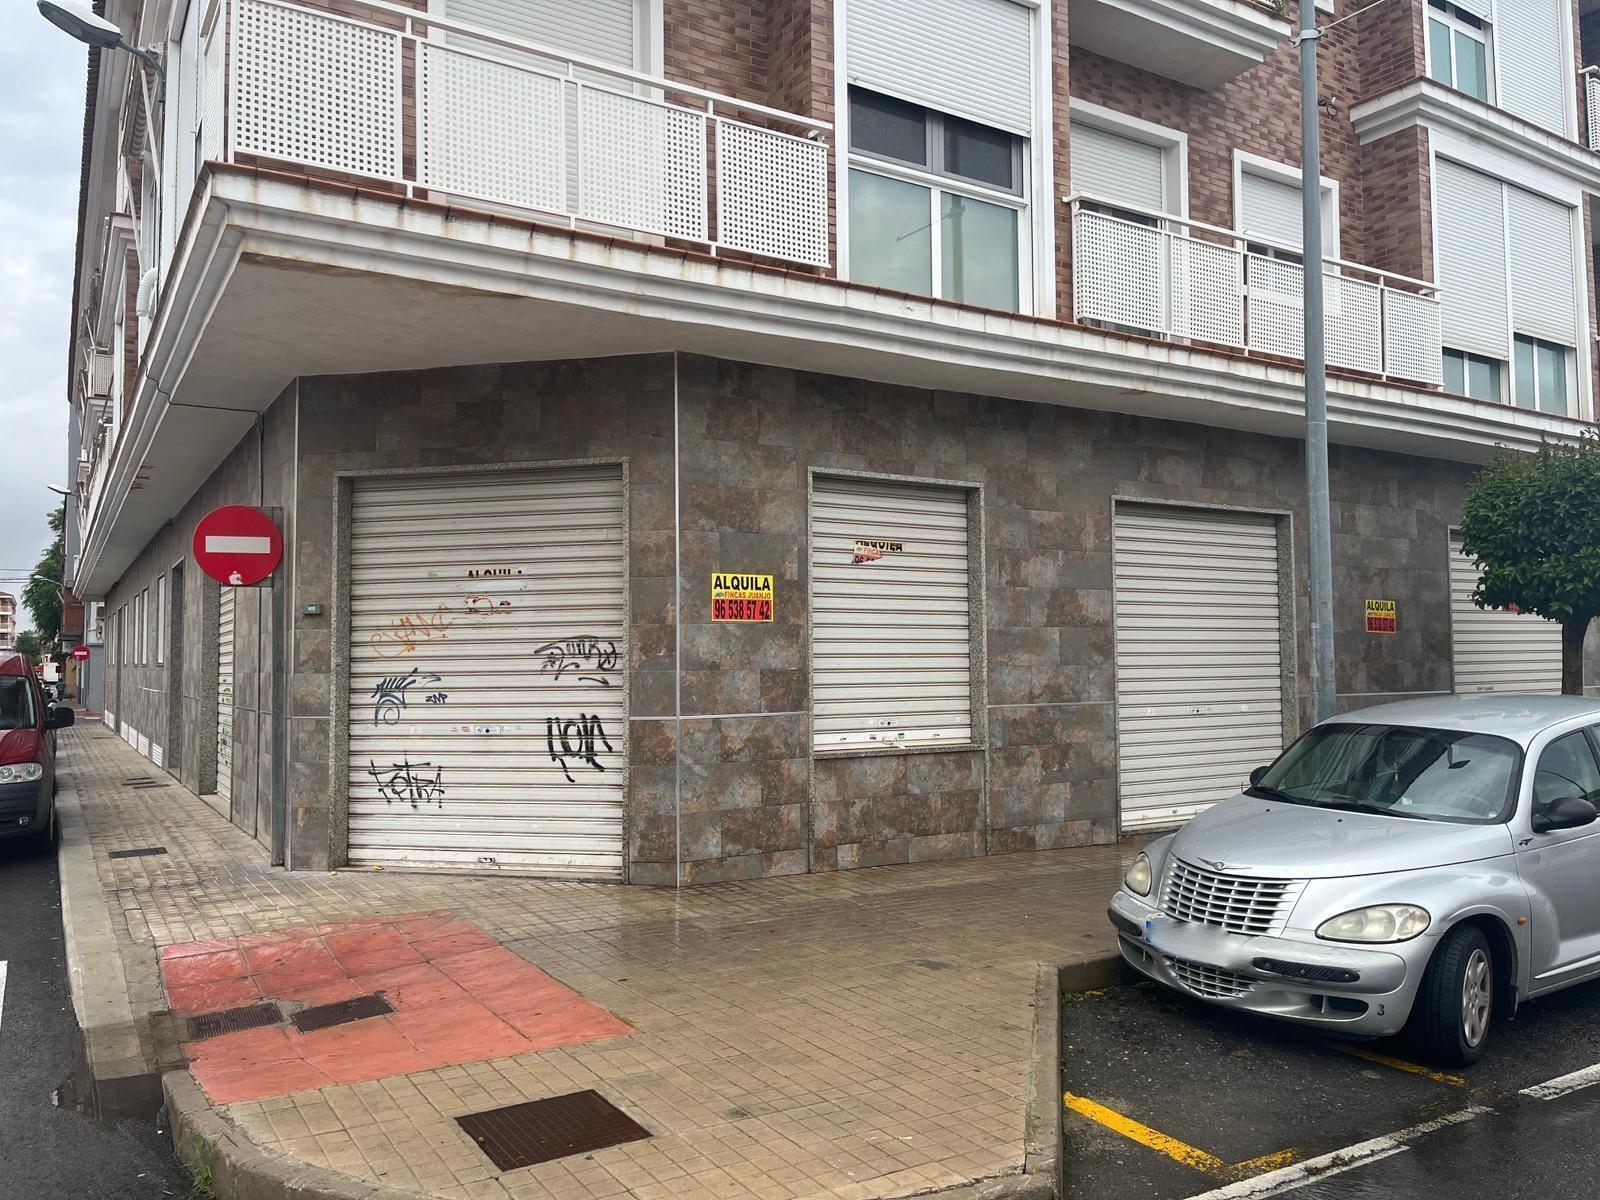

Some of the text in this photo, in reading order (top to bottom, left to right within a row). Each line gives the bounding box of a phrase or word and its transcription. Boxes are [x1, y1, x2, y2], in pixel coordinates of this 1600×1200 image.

[714, 576, 771, 591] ALQUILA
[724, 591, 746, 599] FINCAS
[715, 599, 770, 620] 96 538 57 42
[1367, 601, 1394, 611] ALQUILA
